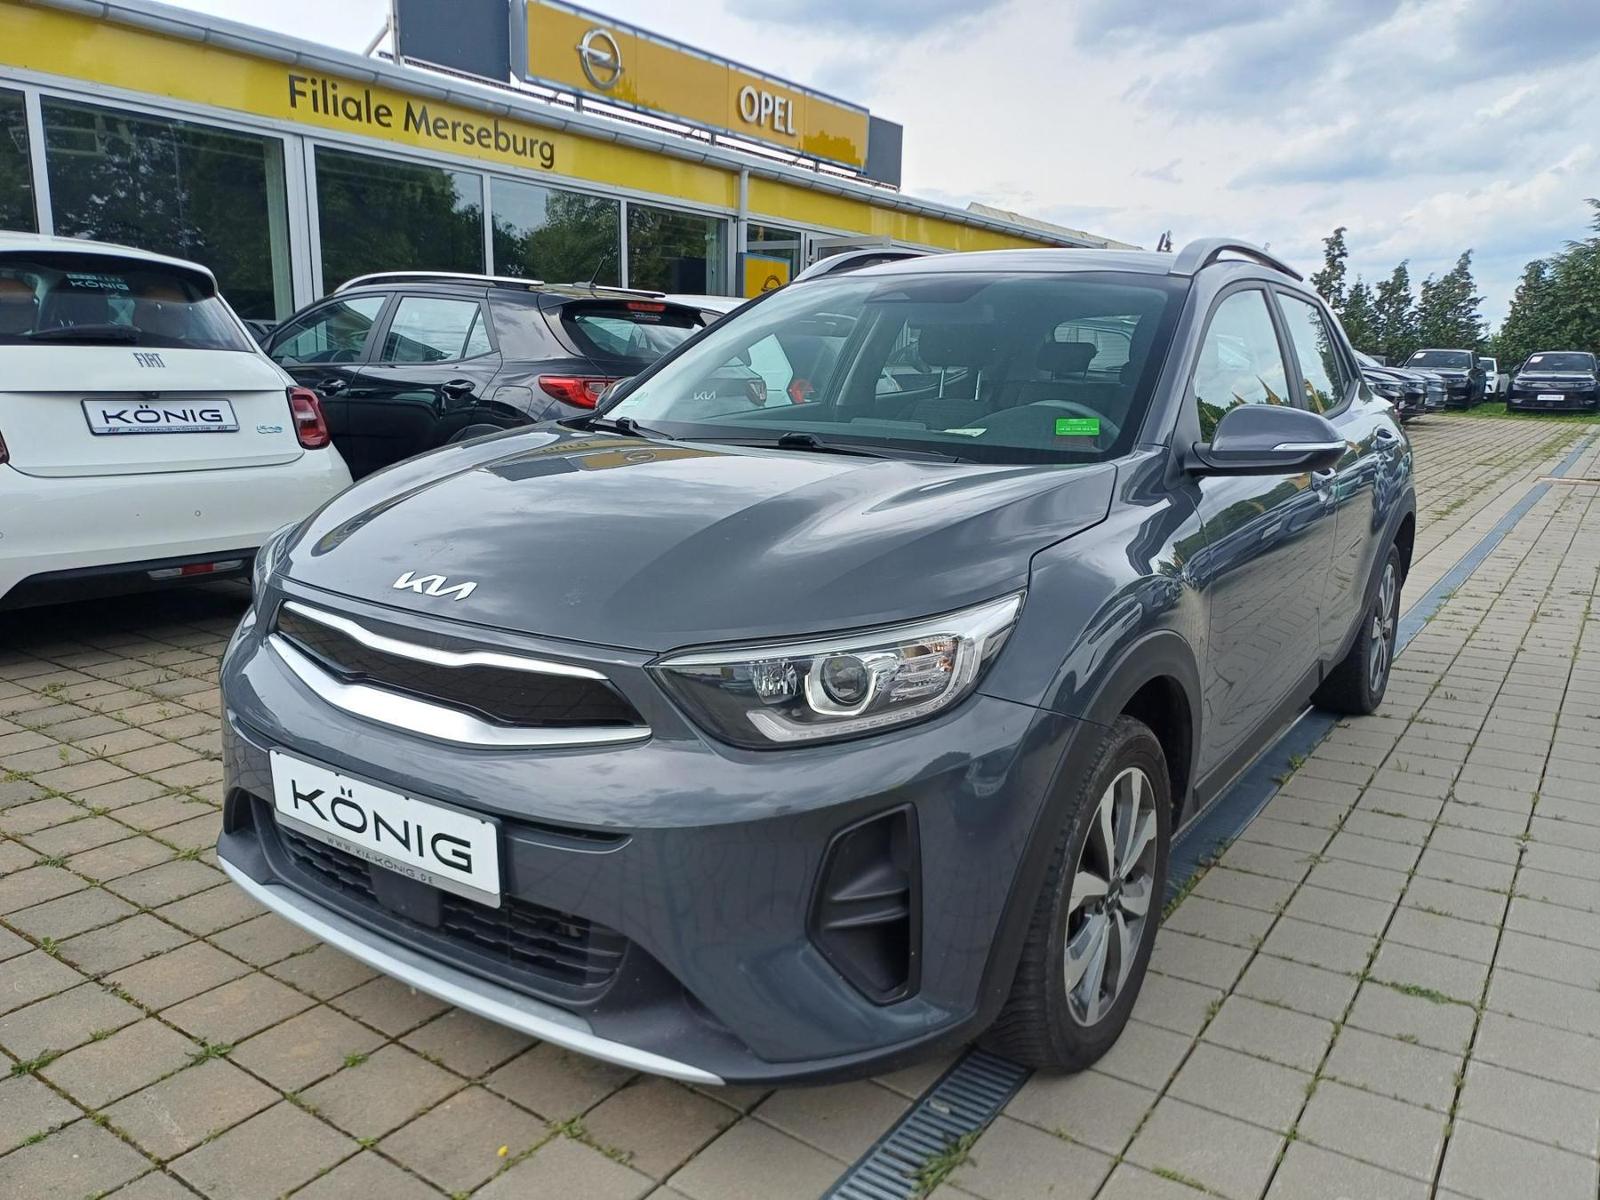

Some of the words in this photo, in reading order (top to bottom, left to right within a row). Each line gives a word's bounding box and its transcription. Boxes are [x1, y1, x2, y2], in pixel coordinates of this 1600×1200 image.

[289, 75, 392, 128] Filiale
[403, 102, 555, 169] Merseburg
[738, 85, 796, 135] OPEL
[133, 352, 167, 368] FIAT
[102, 404, 224, 424] KÖNIG
[392, 570, 477, 601] KIA
[291, 779, 473, 874] KÖNIG
